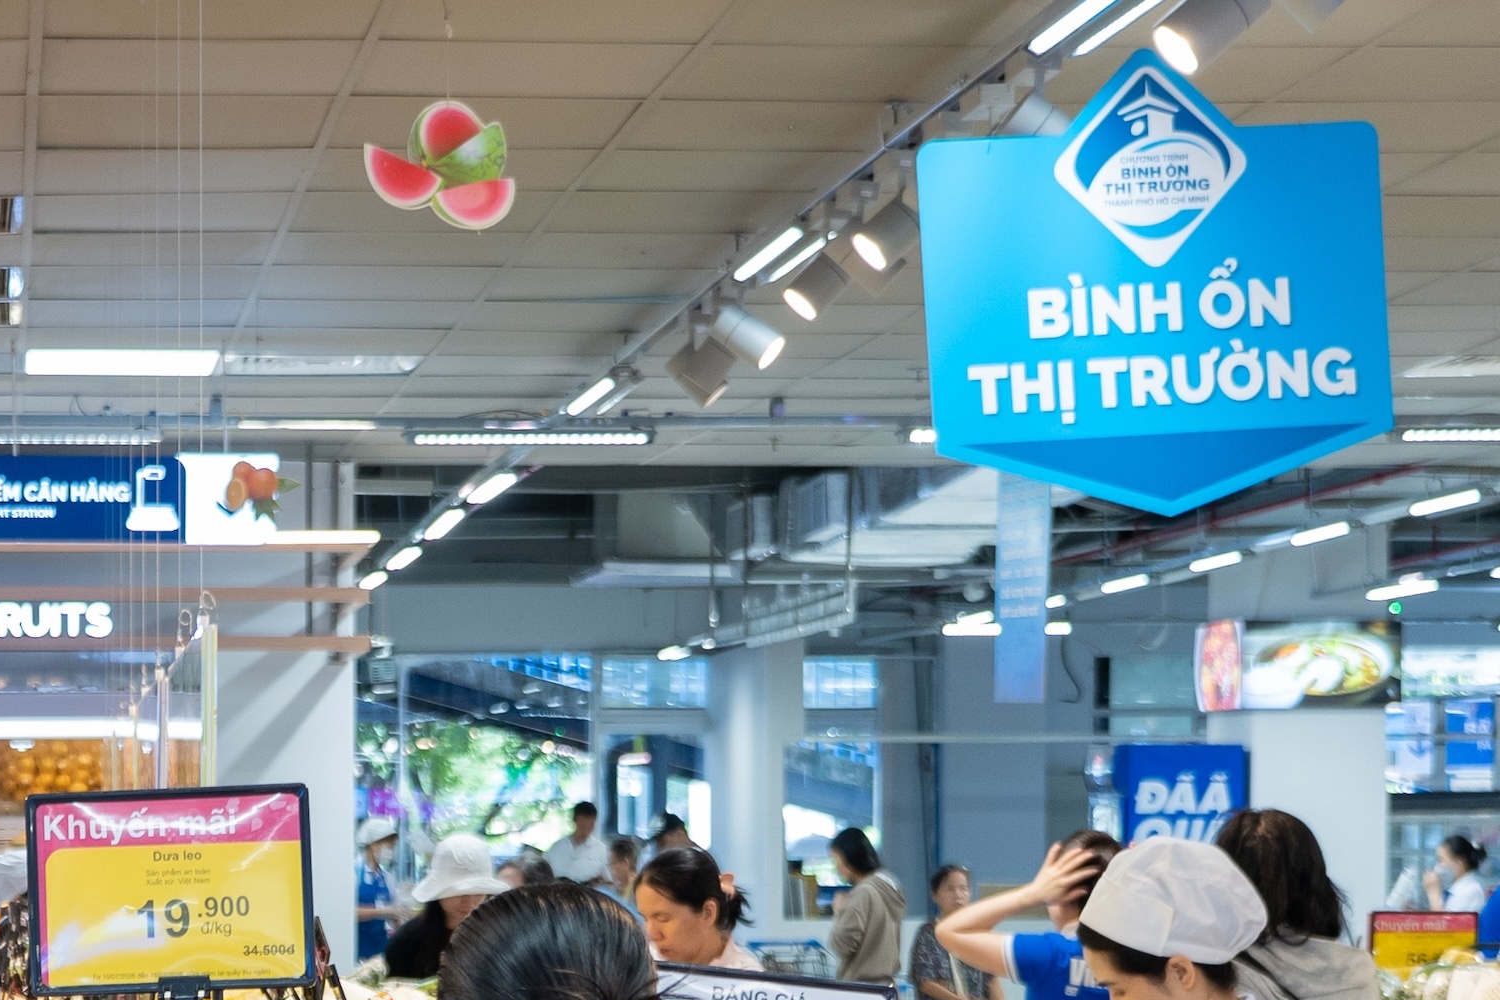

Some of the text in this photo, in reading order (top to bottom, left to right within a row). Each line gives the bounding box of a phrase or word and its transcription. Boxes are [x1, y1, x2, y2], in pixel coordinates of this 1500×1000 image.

[1121, 165, 1161, 180] BÌNH
[1103, 177, 1210, 197] THỊ TRƯỜNG
[1187, 195, 1209, 203] MINH
[1027, 257, 1291, 340] BÌNH ỔN
[967, 338, 1358, 425] THỊ TRƯỜNG
[24, 476, 69, 503] CÂN
[70, 476, 132, 503] HÀNG
[11, 505, 57, 518] STATION
[43, 807, 237, 845] Khuyến mãi
[153, 850, 202, 862] Dưa leo
[193, 877, 211, 885] Nam
